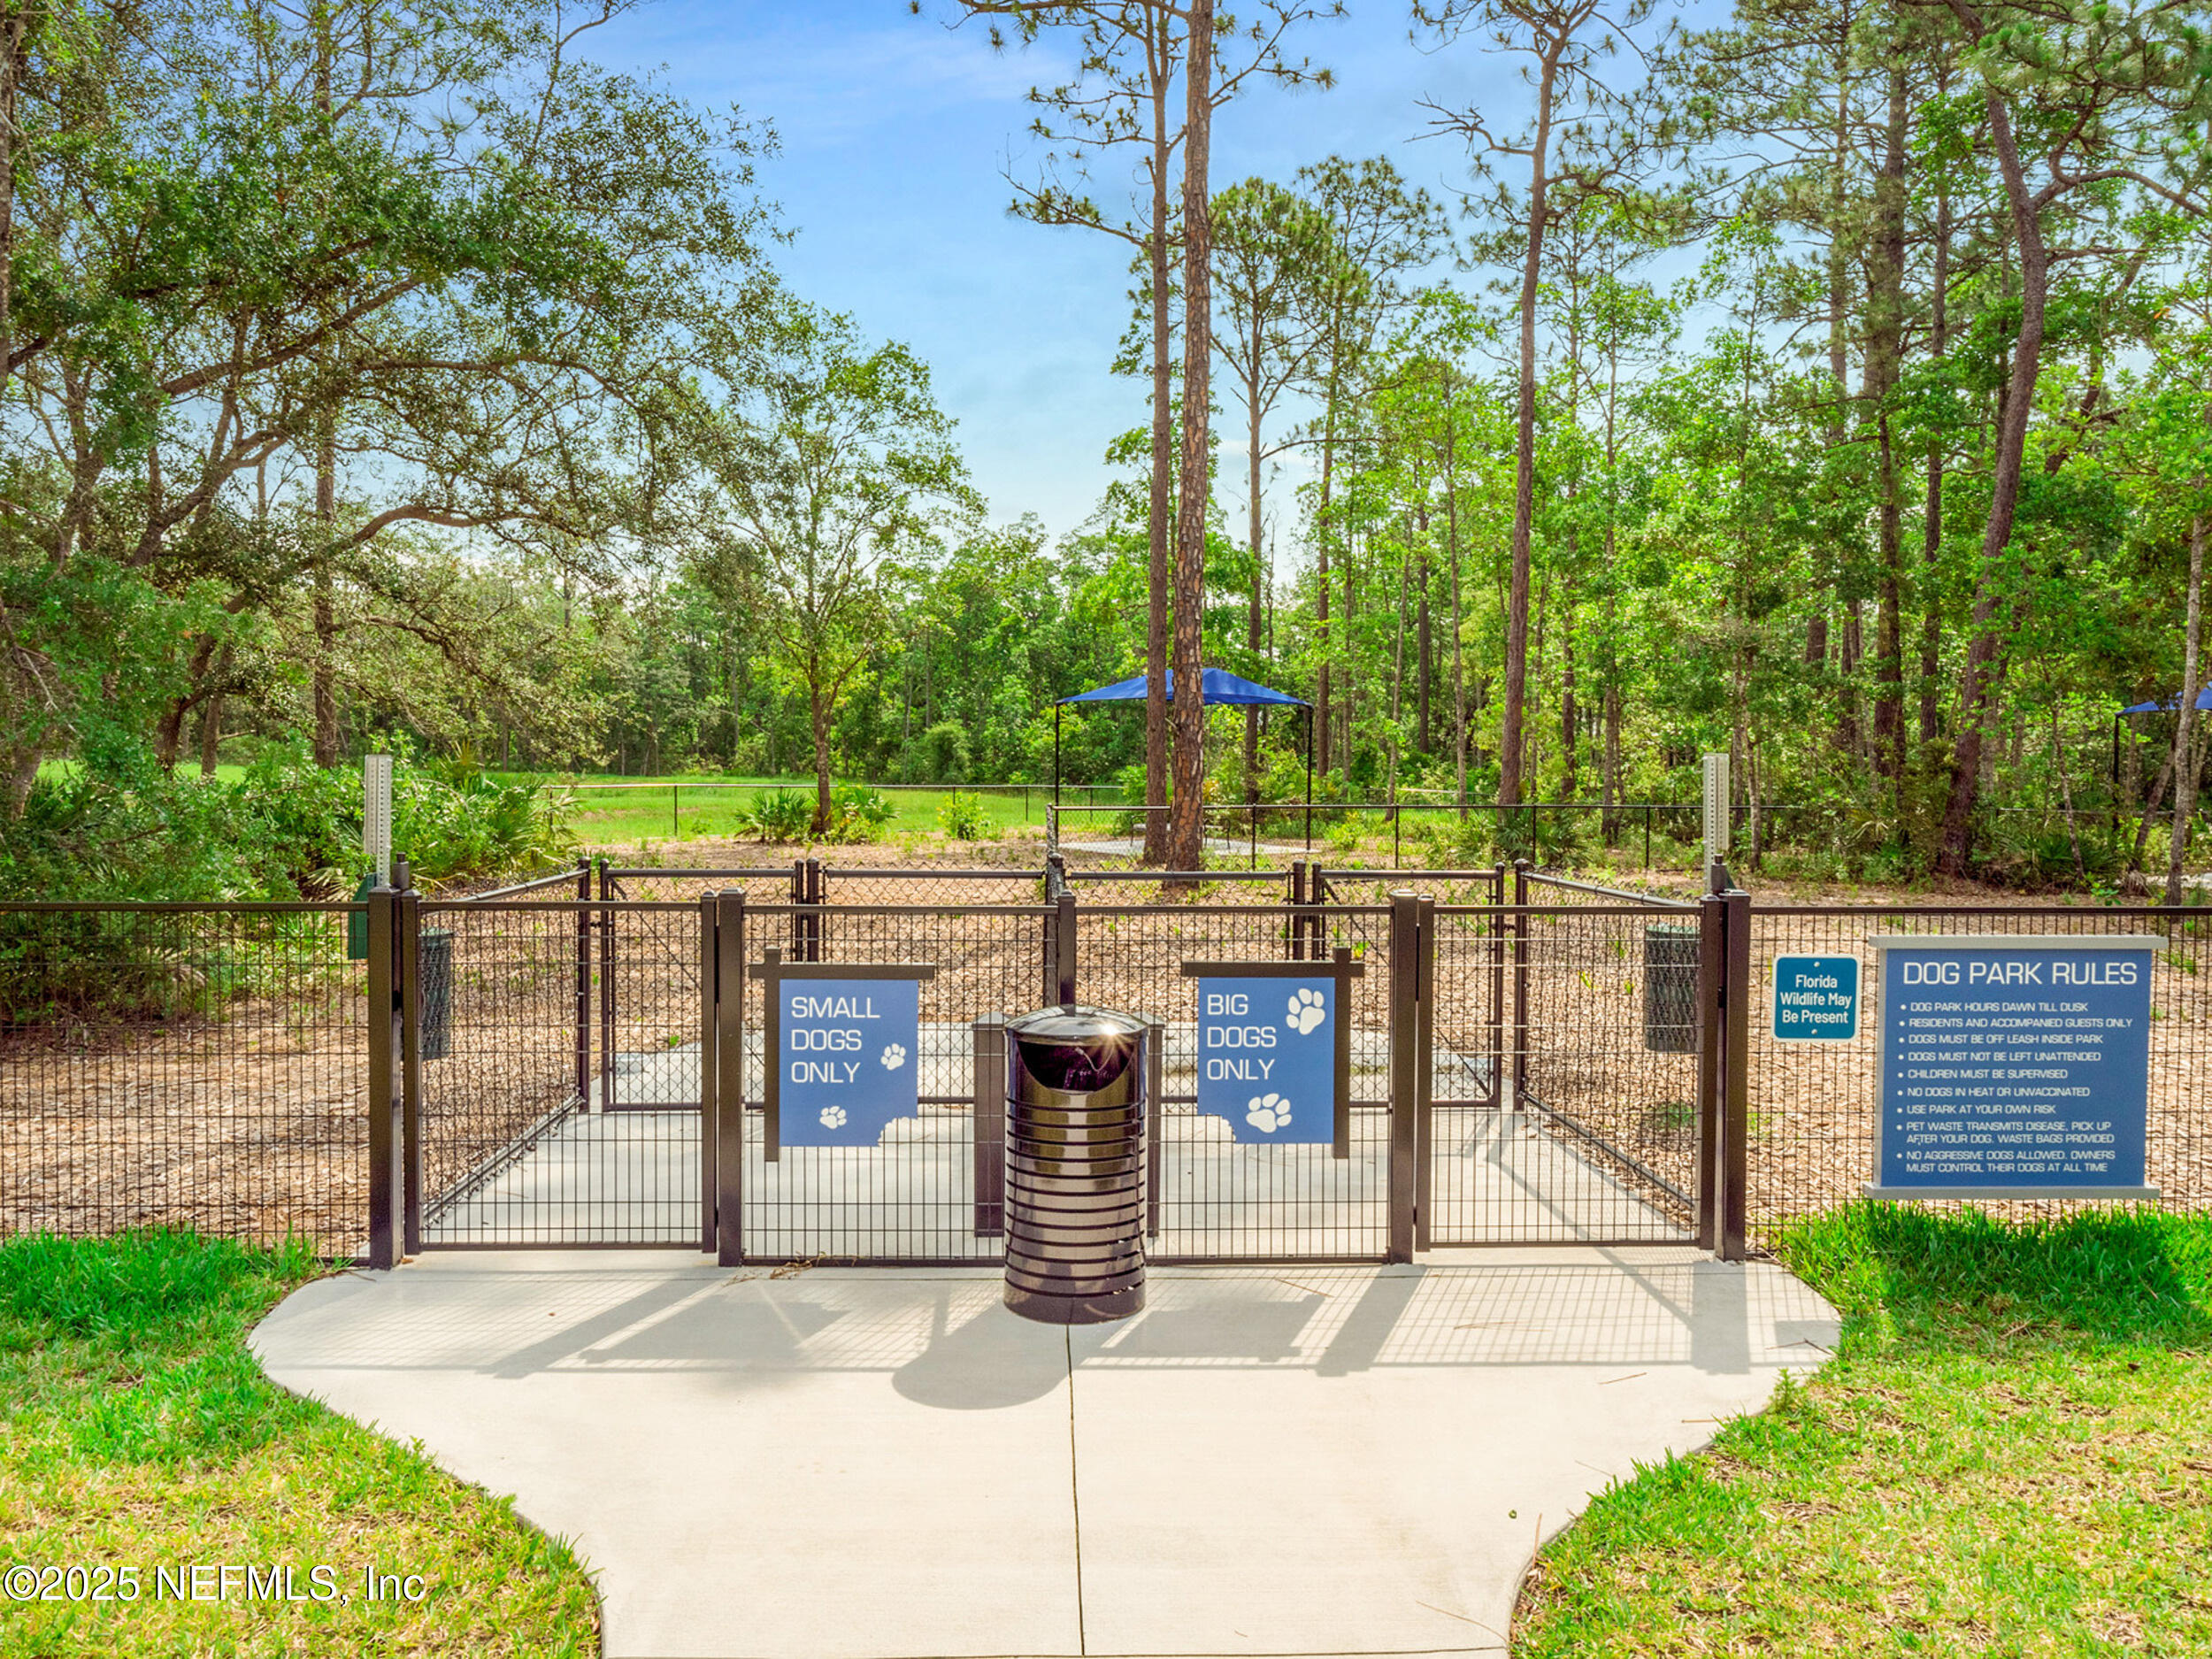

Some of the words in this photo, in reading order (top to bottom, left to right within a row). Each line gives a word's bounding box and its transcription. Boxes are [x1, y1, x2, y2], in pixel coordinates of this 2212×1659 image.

[1904, 962, 1960, 984] DOG
[1970, 963, 2042, 984] PARK
[2053, 963, 2137, 985] RULES
[1796, 974, 1837, 988] Florida
[1208, 995, 1248, 1015] BIG
[1780, 992, 1825, 1005] Wildlife
[1828, 993, 1852, 1009] May
[792, 997, 880, 1018] SMALL
[1910, 1002, 1932, 1011] DOG
[1934, 1002, 1962, 1011] PARK
[1964, 1002, 2000, 1011] HOURS
[2002, 1002, 2035, 1011] DAWN
[2039, 1002, 2057, 1011] TILL
[2060, 1002, 2088, 1011] DUSK
[1782, 1010, 1799, 1023] Be
[1801, 1010, 1848, 1024] Present
[1909, 1018, 1963, 1027] RESIDENTS
[1965, 1018, 1987, 1027] AND
[1991, 1018, 2062, 1027] ACCOMPANIED
[2065, 1018, 2103, 1027] GUESTS
[2106, 1018, 2132, 1027] ONLY
[791, 1029, 862, 1050] DOGS
[1208, 1026, 1277, 1048] DOGS
[1909, 1034, 1937, 1043] DOGS
[1939, 1034, 1968, 1043] MUST
[1970, 1034, 1984, 1043] BE
[1986, 1034, 2004, 1044] OFF
[2007, 1034, 2039, 1043] LEASH
[2041, 1034, 2073, 1043] INSIDE
[2076, 1034, 2102, 1043] PARK
[1909, 1052, 1936, 1061] DOGS
[1939, 1052, 1968, 1061] MUST
[1970, 1052, 1991, 1061] NOT
[1993, 1052, 2006, 1061] BE
[2009, 1052, 2032, 1061] LEFT
[2035, 1052, 2101, 1061] UNATTENDED
[792, 1062, 860, 1083] ONLY
[1207, 1059, 1274, 1079] ONLY
[1908, 1069, 1957, 1079] CHILDREN
[1961, 1069, 1989, 1079] MUST
[1993, 1069, 2005, 1079] BE
[2008, 1069, 2068, 1079] SUPERVISED
[1908, 1087, 1923, 1096] NO
[1925, 1087, 1953, 1096] DOGS
[1955, 1087, 1966, 1096] IN
[1969, 1087, 1994, 1096] HEAT
[1997, 1087, 2011, 1096] OR
[2014, 1087, 2090, 1096] UNVACCINATED
[1907, 1105, 1926, 1114] USE
[1929, 1104, 1956, 1113] PARK
[1959, 1104, 1972, 1113] AT
[1975, 1104, 2002, 1114] YOUR
[2005, 1104, 2031, 1114] OWN
[2033, 1105, 2055, 1114] RISK
[1907, 1122, 1925, 1131] PET
[1928, 1122, 1962, 1131] WASTE
[1966, 1122, 2024, 1131] TRANSMITS
[2071, 1122, 2094, 1131] PICK
[2097, 1122, 2111, 1131] UP
[1907, 1134, 1938, 1143] AFTER
[1940, 1134, 1968, 1143] YOUR
[1997, 1134, 2032, 1143] WASTE
[2036, 1134, 2063, 1143] BAGS
[2065, 1133, 2115, 1143] PROVIDED
[1907, 1151, 1922, 1160] NO
[1924, 1151, 1983, 1160] AGGRESSIVE
[1986, 1151, 2014, 1160] DOGS
[2070, 1150, 2116, 1159] OWNERS
[1907, 1164, 1935, 1172] MUST
[1938, 1164, 1984, 1172] CONTROL
[1987, 1164, 2015, 1172] THEIR
[2017, 1163, 2045, 1171] DOGS
[2047, 1163, 2061, 1171] AT
[2085, 1163, 2108, 1171] TIME
